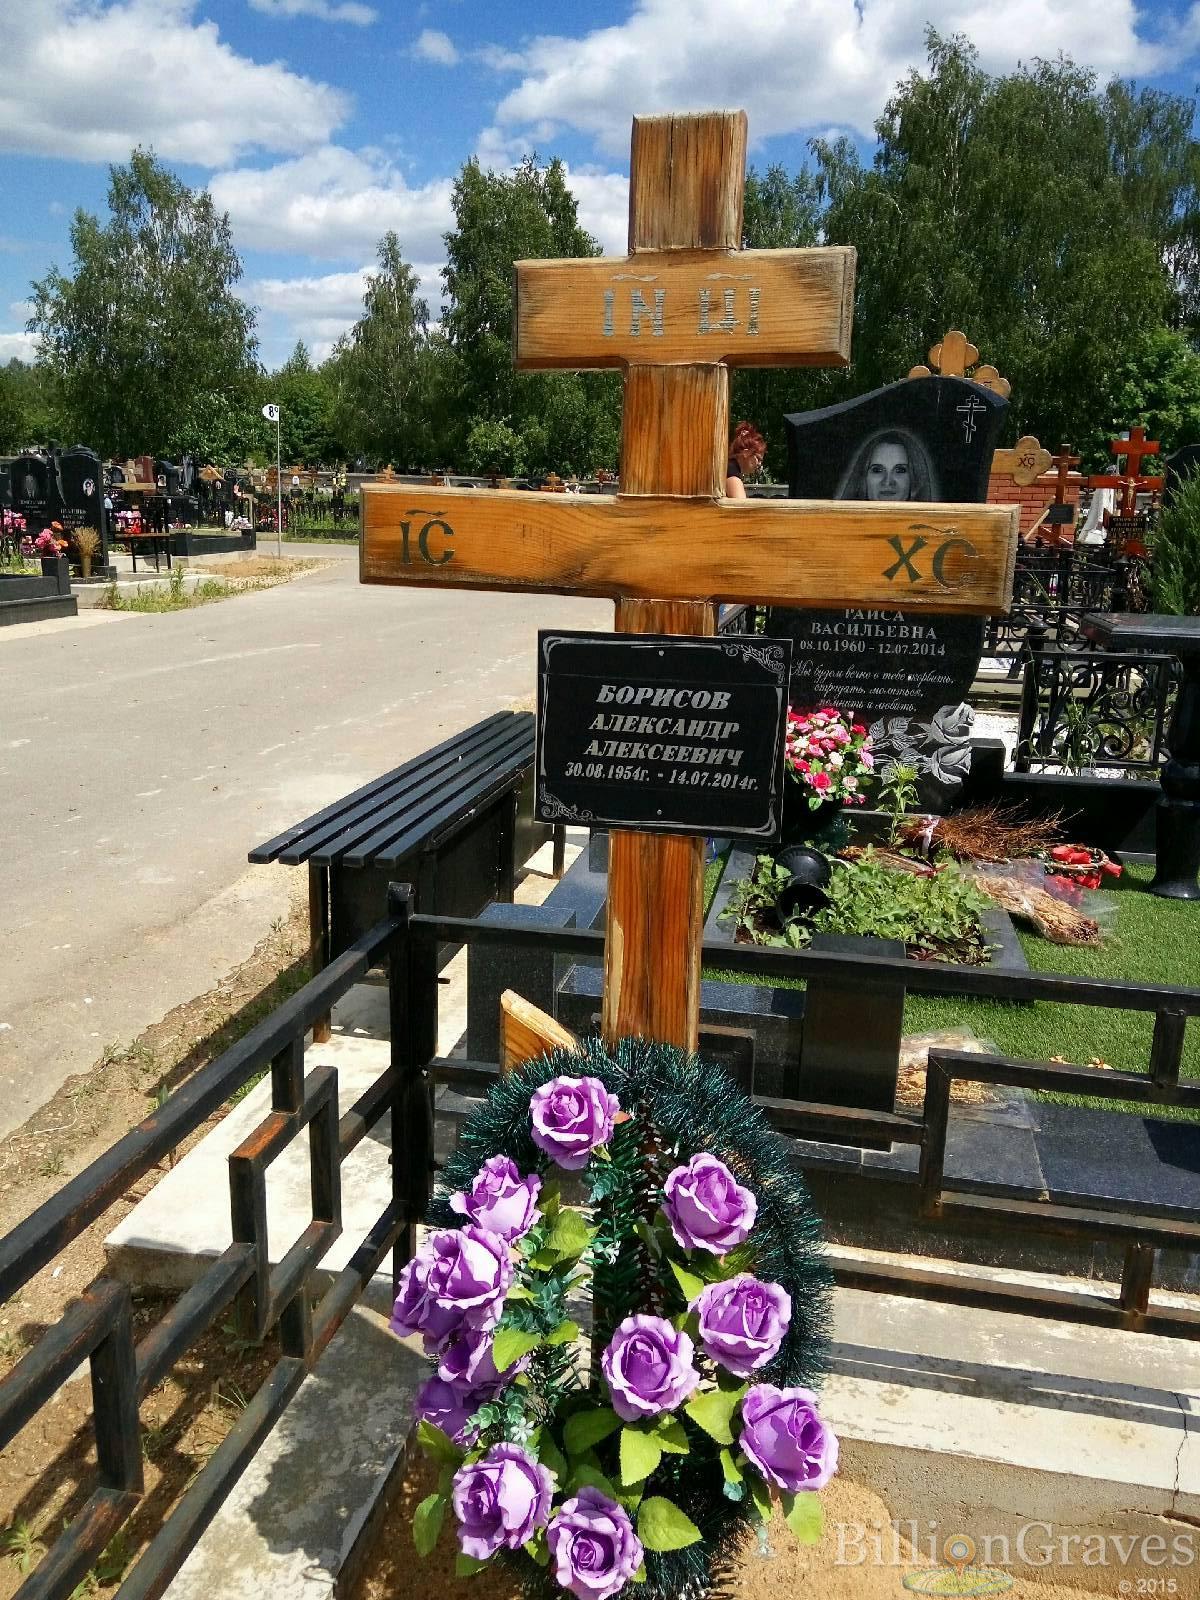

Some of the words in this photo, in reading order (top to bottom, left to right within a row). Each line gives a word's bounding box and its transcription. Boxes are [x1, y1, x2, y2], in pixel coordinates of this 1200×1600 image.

[811, 622, 938, 640] ВАСИЛЬЕВНА
[800, 639, 866, 653] 08.10.1960
[879, 642, 947, 656] 12.07.2014
[596, 684, 732, 711] БОРИСОВ
[588, 713, 740, 742] АЛЕКСАНДР
[584, 739, 745, 767] АЛЕКСЕЕВИЧ
[564, 762, 650, 782] 30.08.1954г.
[668, 769, 759, 791] 14.07.2014г.
